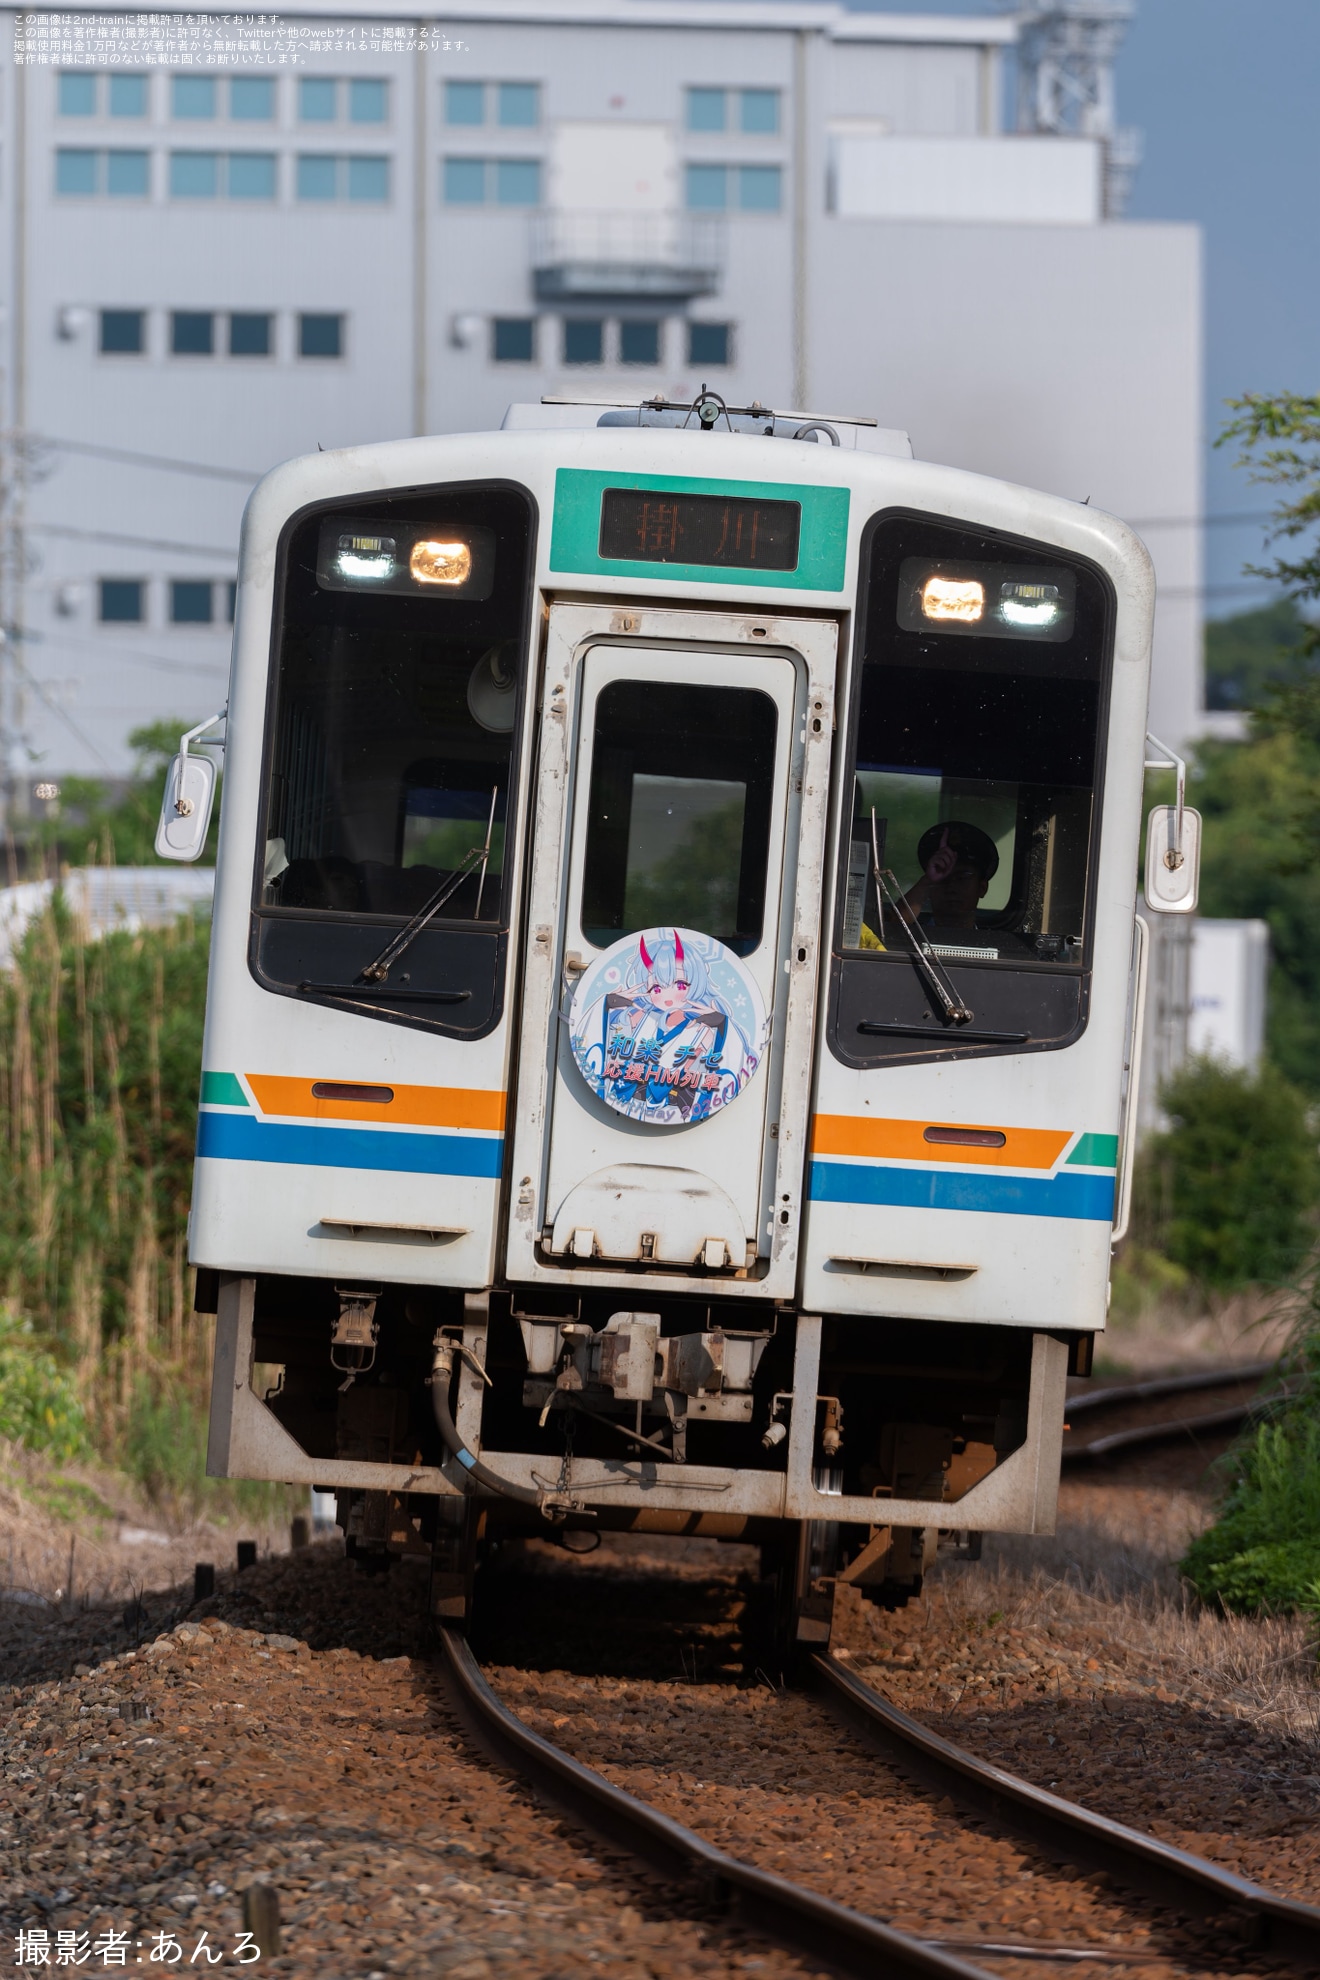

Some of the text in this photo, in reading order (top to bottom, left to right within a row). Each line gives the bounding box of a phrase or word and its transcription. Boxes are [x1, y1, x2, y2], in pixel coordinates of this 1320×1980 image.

[637, 503, 760, 559] 掛川
[607, 1033, 723, 1068] 和楽 チセ
[602, 1059, 722, 1091] 応援HM列車
